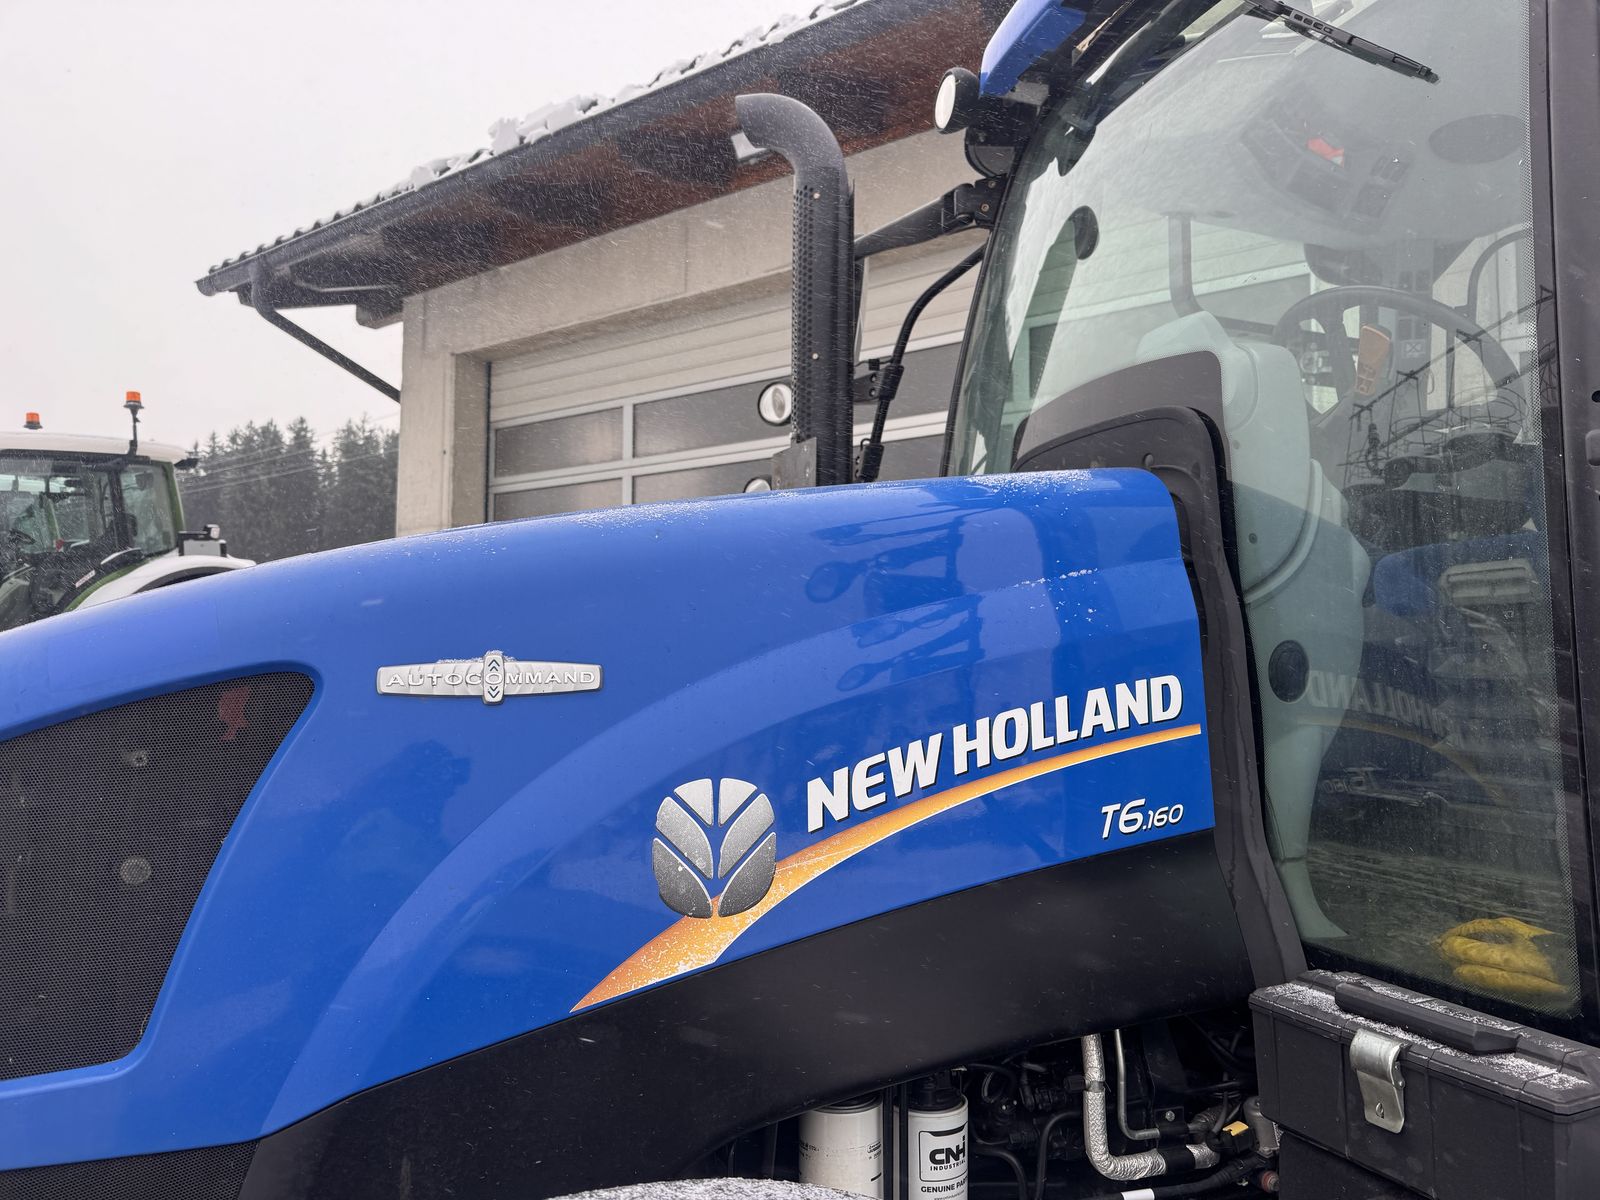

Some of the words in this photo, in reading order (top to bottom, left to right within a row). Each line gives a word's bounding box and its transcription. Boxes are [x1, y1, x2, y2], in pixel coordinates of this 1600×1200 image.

[386, 671, 595, 686] AUTOCOMMAND
[807, 733, 943, 834] NEW
[952, 674, 1183, 776] HOLLAND
[1101, 798, 1184, 839] T6.160
[920, 1183, 956, 1193] GENUINE
